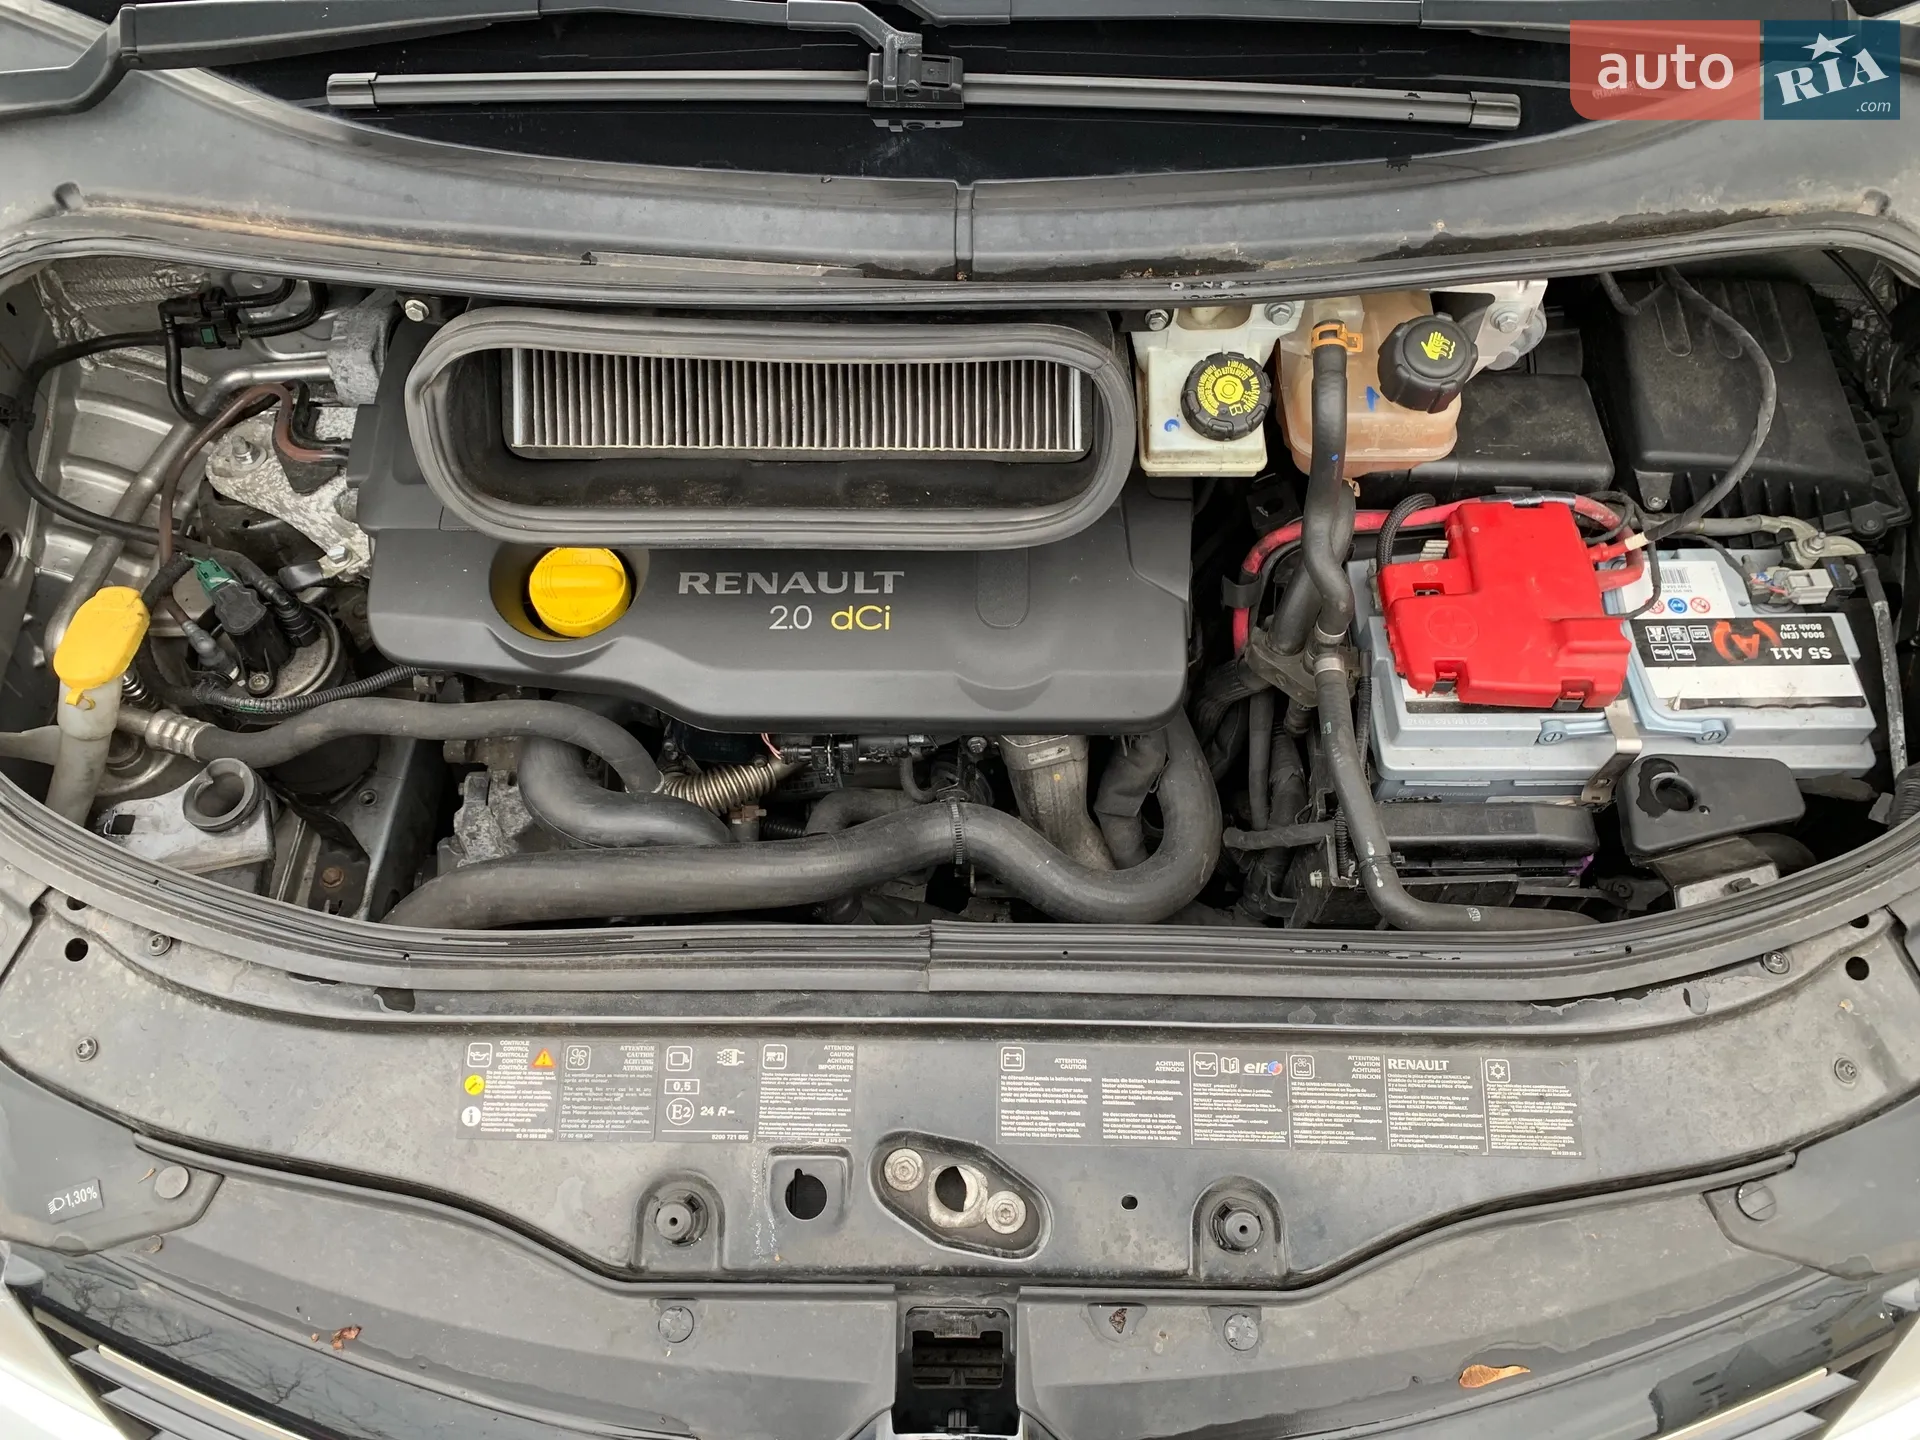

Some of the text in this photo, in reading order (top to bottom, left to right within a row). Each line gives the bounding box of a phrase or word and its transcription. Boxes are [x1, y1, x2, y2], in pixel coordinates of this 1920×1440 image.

[1244, 376, 1260, 412] WARNING
[678, 571, 904, 594] RENAULT
[769, 604, 892, 630] 2.0 dCi
[1780, 631, 1799, 639] (EN)
[1770, 647, 1832, 660] S5 A11
[1244, 1062, 1268, 1074] elf
[1388, 1058, 1449, 1071] RENAULT
[673, 1082, 691, 1092] 0,5
[671, 1105, 691, 1120] E2
[700, 1106, 714, 1116] 24
[65, 1186, 98, 1208] 1,30%
